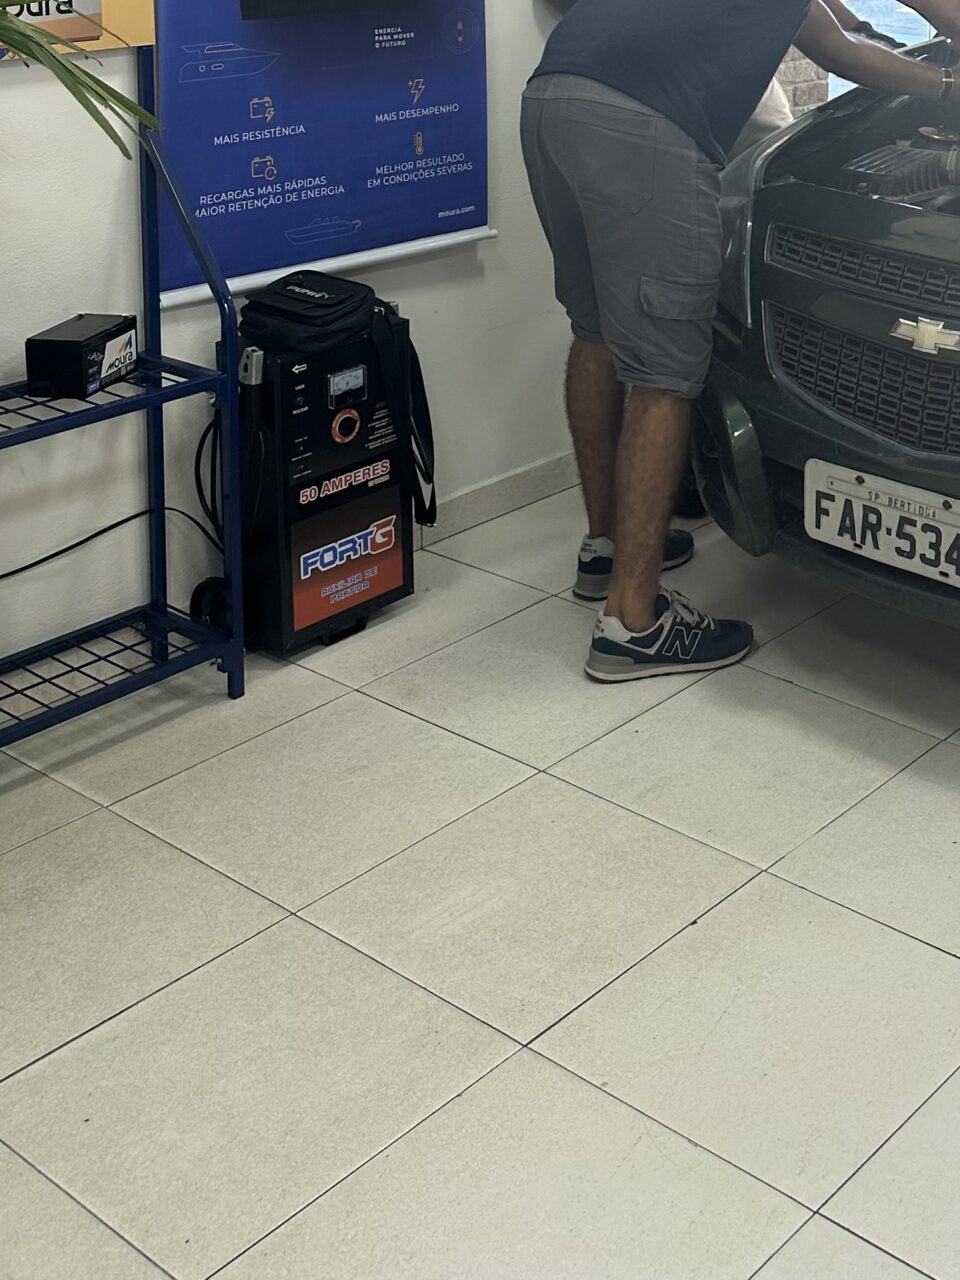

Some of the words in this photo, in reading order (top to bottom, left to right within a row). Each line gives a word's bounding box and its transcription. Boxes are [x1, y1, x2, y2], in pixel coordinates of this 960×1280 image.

[393, 32, 415, 40] MOVER
[375, 112, 397, 123] MAIS
[399, 103, 460, 120] DESEMPENHO
[213, 133, 240, 146] MAIS
[242, 124, 306, 142] RESISTÊNCIA
[367, 178, 381, 188] EM
[383, 168, 436, 186] CONDIÇÕES
[437, 162, 473, 176] SEVERAS
[375, 161, 415, 176] MELHOR
[416, 152, 465, 169] RESULTADO
[199, 187, 255, 206] RECARGAS
[257, 183, 282, 196] MAIS
[284, 175, 328, 190] RÁPIDAS
[228, 195, 283, 213] RETENÇÃO
[285, 191, 299, 202] DE
[301, 184, 345, 200] ENERGIA
[437, 205, 476, 218] moura.com
[299, 485, 318, 505] 50
[320, 459, 391, 498] AMPERES
[867, 491, 880, 502] SP
[887, 496, 937, 519] BERTIOGA
[320, 571, 363, 598] AUXILIAR
[363, 566, 378, 580] DE
[330, 580, 370, 604] PARTIDA
[662, 625, 702, 660] N
